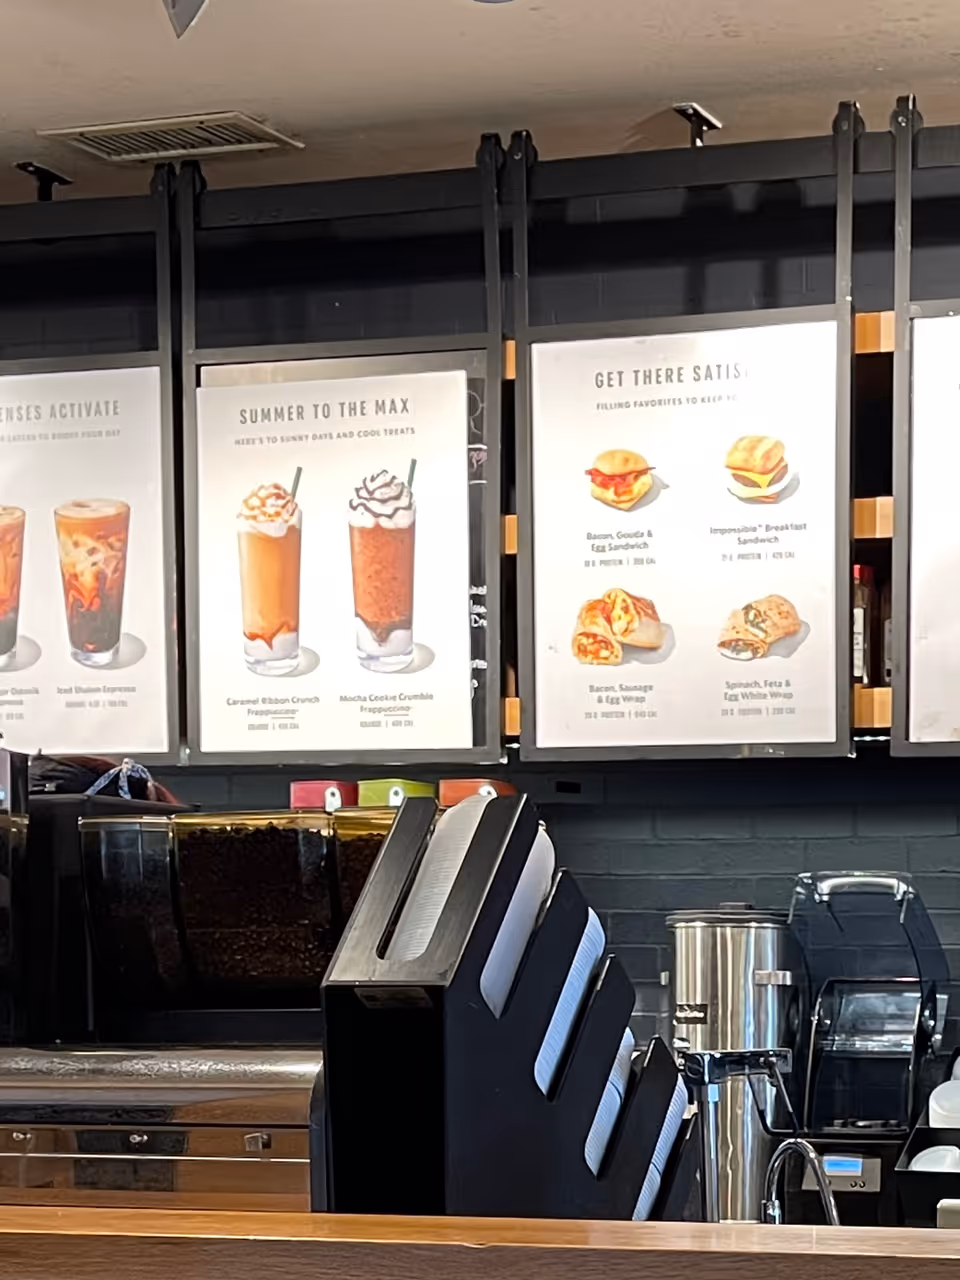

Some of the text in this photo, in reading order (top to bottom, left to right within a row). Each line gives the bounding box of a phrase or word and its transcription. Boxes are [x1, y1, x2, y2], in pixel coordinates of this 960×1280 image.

[594, 362, 748, 389] GET THERE SATIS
[633, 397, 683, 408] FAVORITES
[49, 400, 120, 420] ACTIVATE
[239, 397, 410, 425] SUMMER TO THE MAX
[765, 522, 807, 533] Breakfast
[608, 540, 649, 552] Sandwich
[737, 535, 780, 546] Sandwich
[291, 695, 320, 704] Crunch
